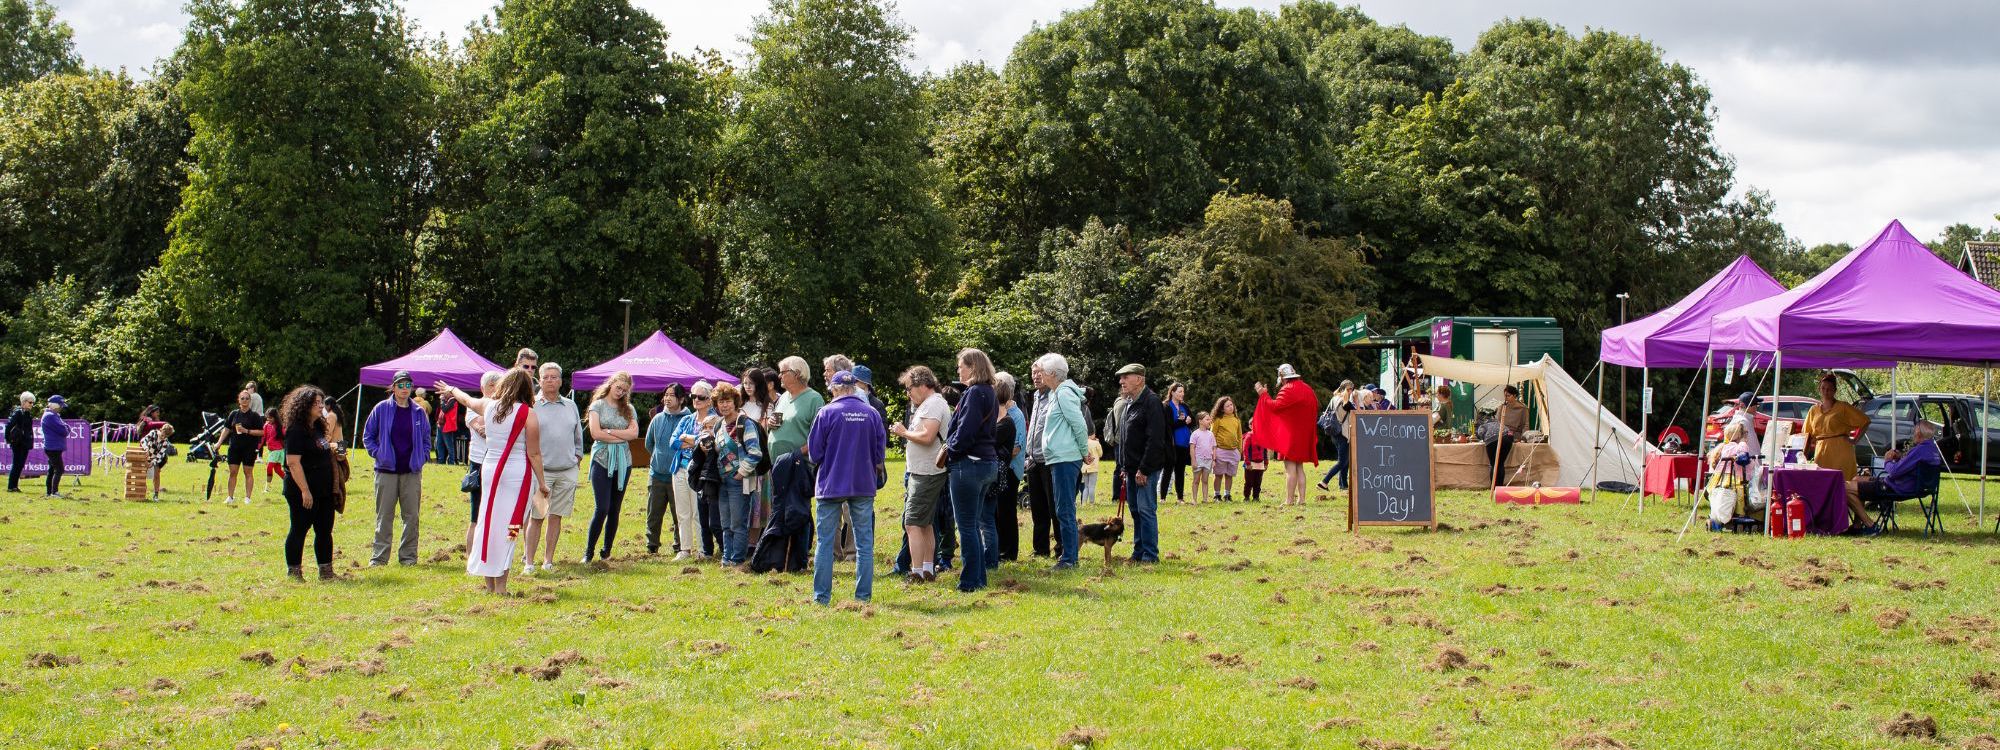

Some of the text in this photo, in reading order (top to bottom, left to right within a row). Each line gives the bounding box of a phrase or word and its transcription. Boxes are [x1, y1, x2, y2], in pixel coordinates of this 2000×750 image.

[1360, 416, 1427, 440] Welcome
[1373, 445, 1396, 467] To
[1362, 466, 1414, 491] Roman
[1377, 491, 1415, 522] Day!
